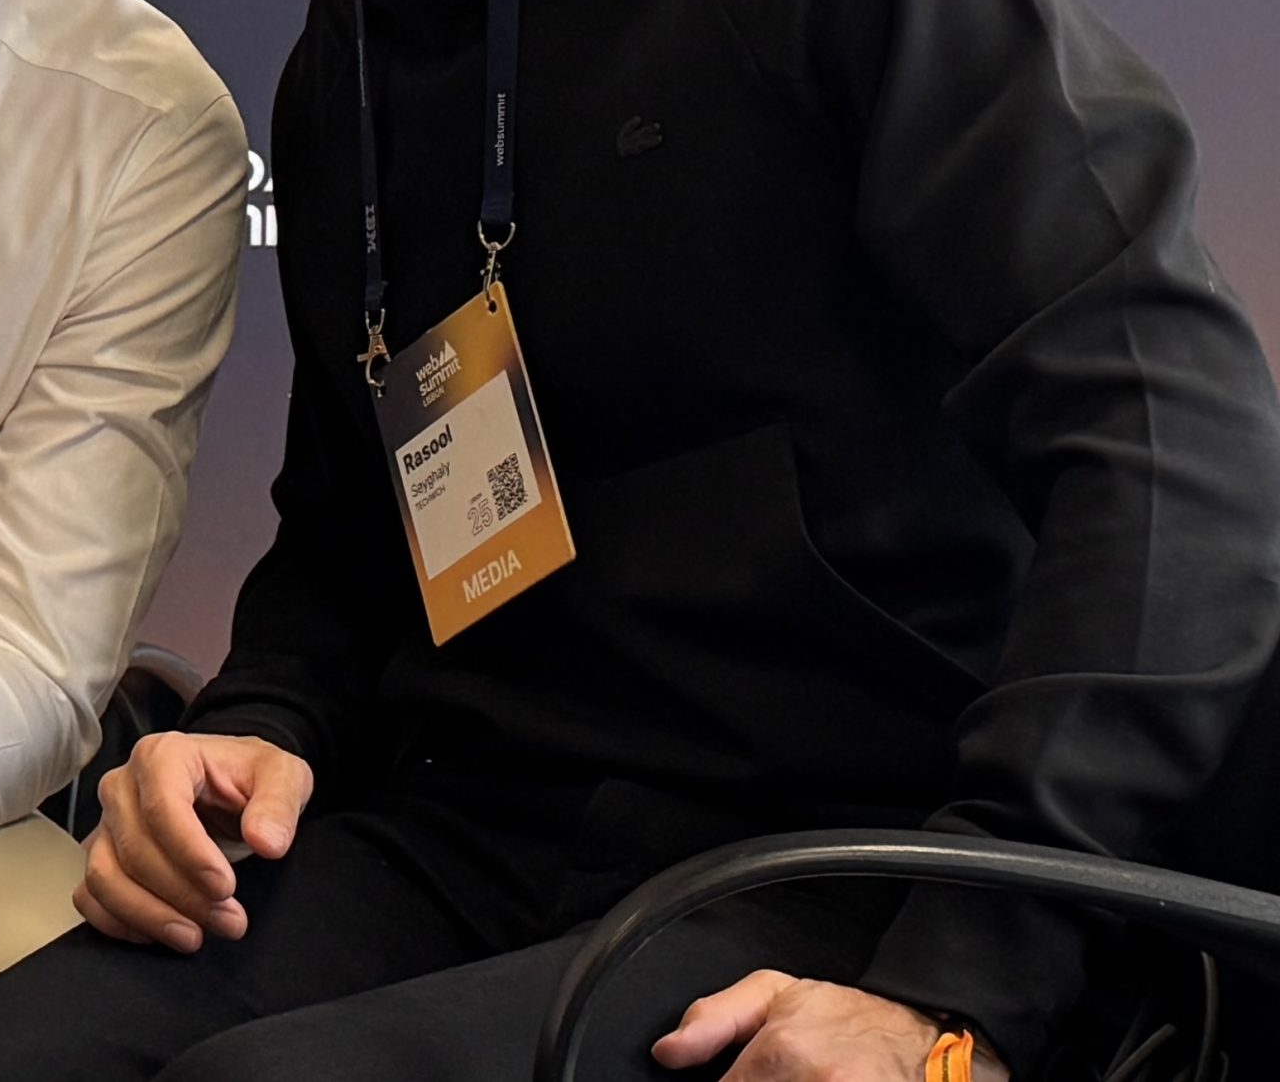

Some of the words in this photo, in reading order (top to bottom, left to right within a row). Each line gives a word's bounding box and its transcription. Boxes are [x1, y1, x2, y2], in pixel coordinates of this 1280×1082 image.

[364, 204, 375, 254] IBM
[415, 353, 440, 383] web
[418, 356, 463, 397] summit
[402, 423, 453, 476] Rasool
[467, 498, 494, 537] 25
[462, 549, 522, 603] MEDIA
